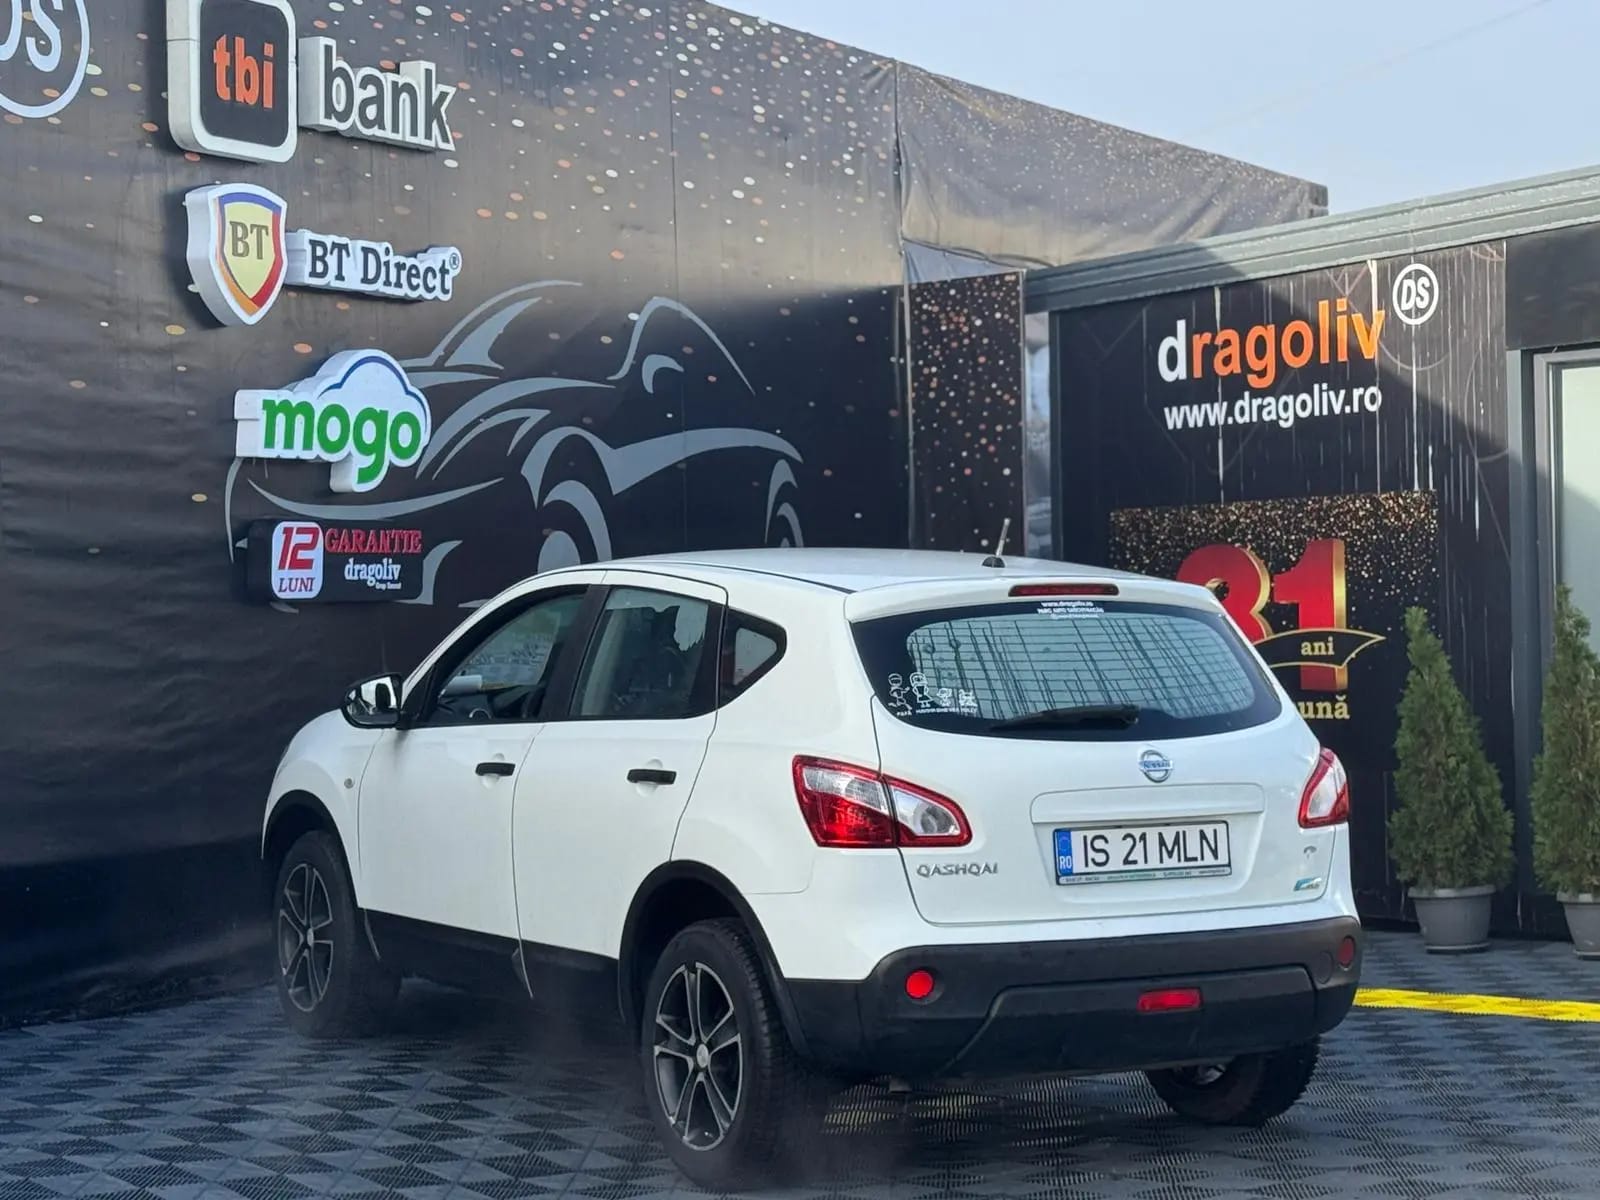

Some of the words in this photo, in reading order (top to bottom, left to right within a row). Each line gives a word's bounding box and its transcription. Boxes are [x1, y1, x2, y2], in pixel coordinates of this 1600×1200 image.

[213, 34, 274, 109] tbi
[323, 44, 454, 150] bank
[229, 220, 270, 260] BT
[308, 239, 350, 281] BT
[1400, 276, 1430, 311] DS
[1157, 297, 1386, 389] dragoliv
[1164, 383, 1383, 431] www.dragoliv.ro
[262, 399, 422, 485] mogo
[278, 526, 320, 571] 12
[324, 528, 423, 554] GARANTIE
[278, 576, 316, 593] LUNI
[344, 556, 402, 587] dragoliv
[1300, 636, 1335, 656] ani
[1059, 855, 1073, 870] RO
[1082, 834, 1110, 868] IS
[1121, 832, 1149, 866] 21
[1157, 828, 1220, 864] MLN
[916, 862, 998, 878] QASHQAI
